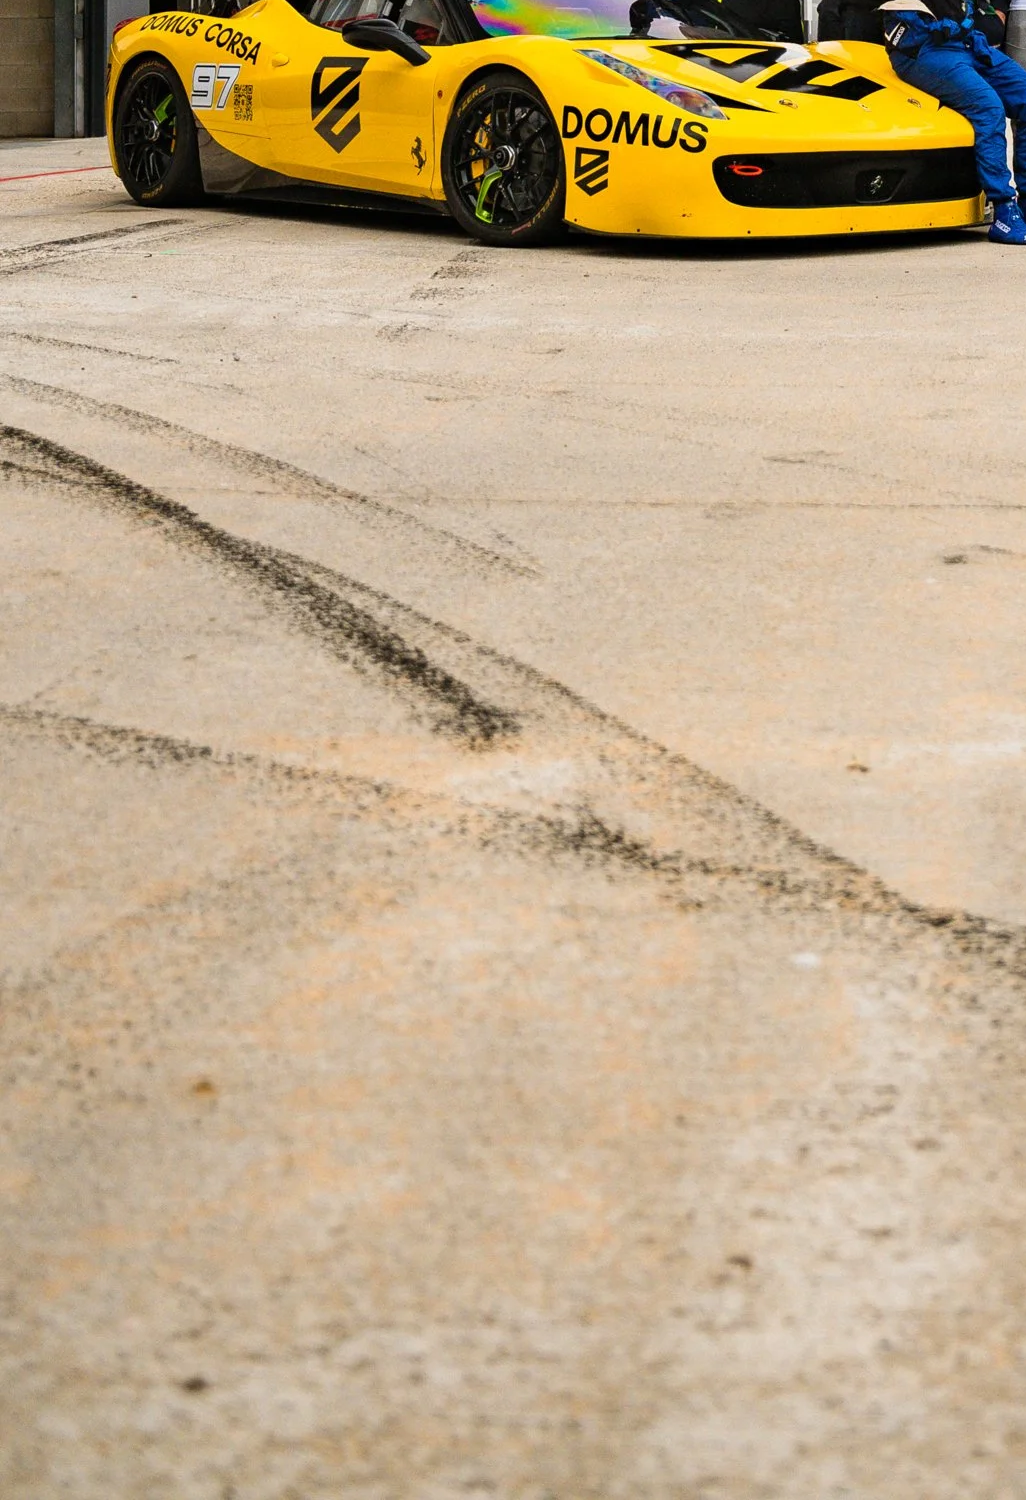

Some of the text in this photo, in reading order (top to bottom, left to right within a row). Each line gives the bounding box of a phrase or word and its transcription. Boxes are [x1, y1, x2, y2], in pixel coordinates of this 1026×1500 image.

[140, 15, 262, 66] DOMUS CORSA
[191, 63, 241, 110] 97
[562, 105, 709, 154] DOMUS
